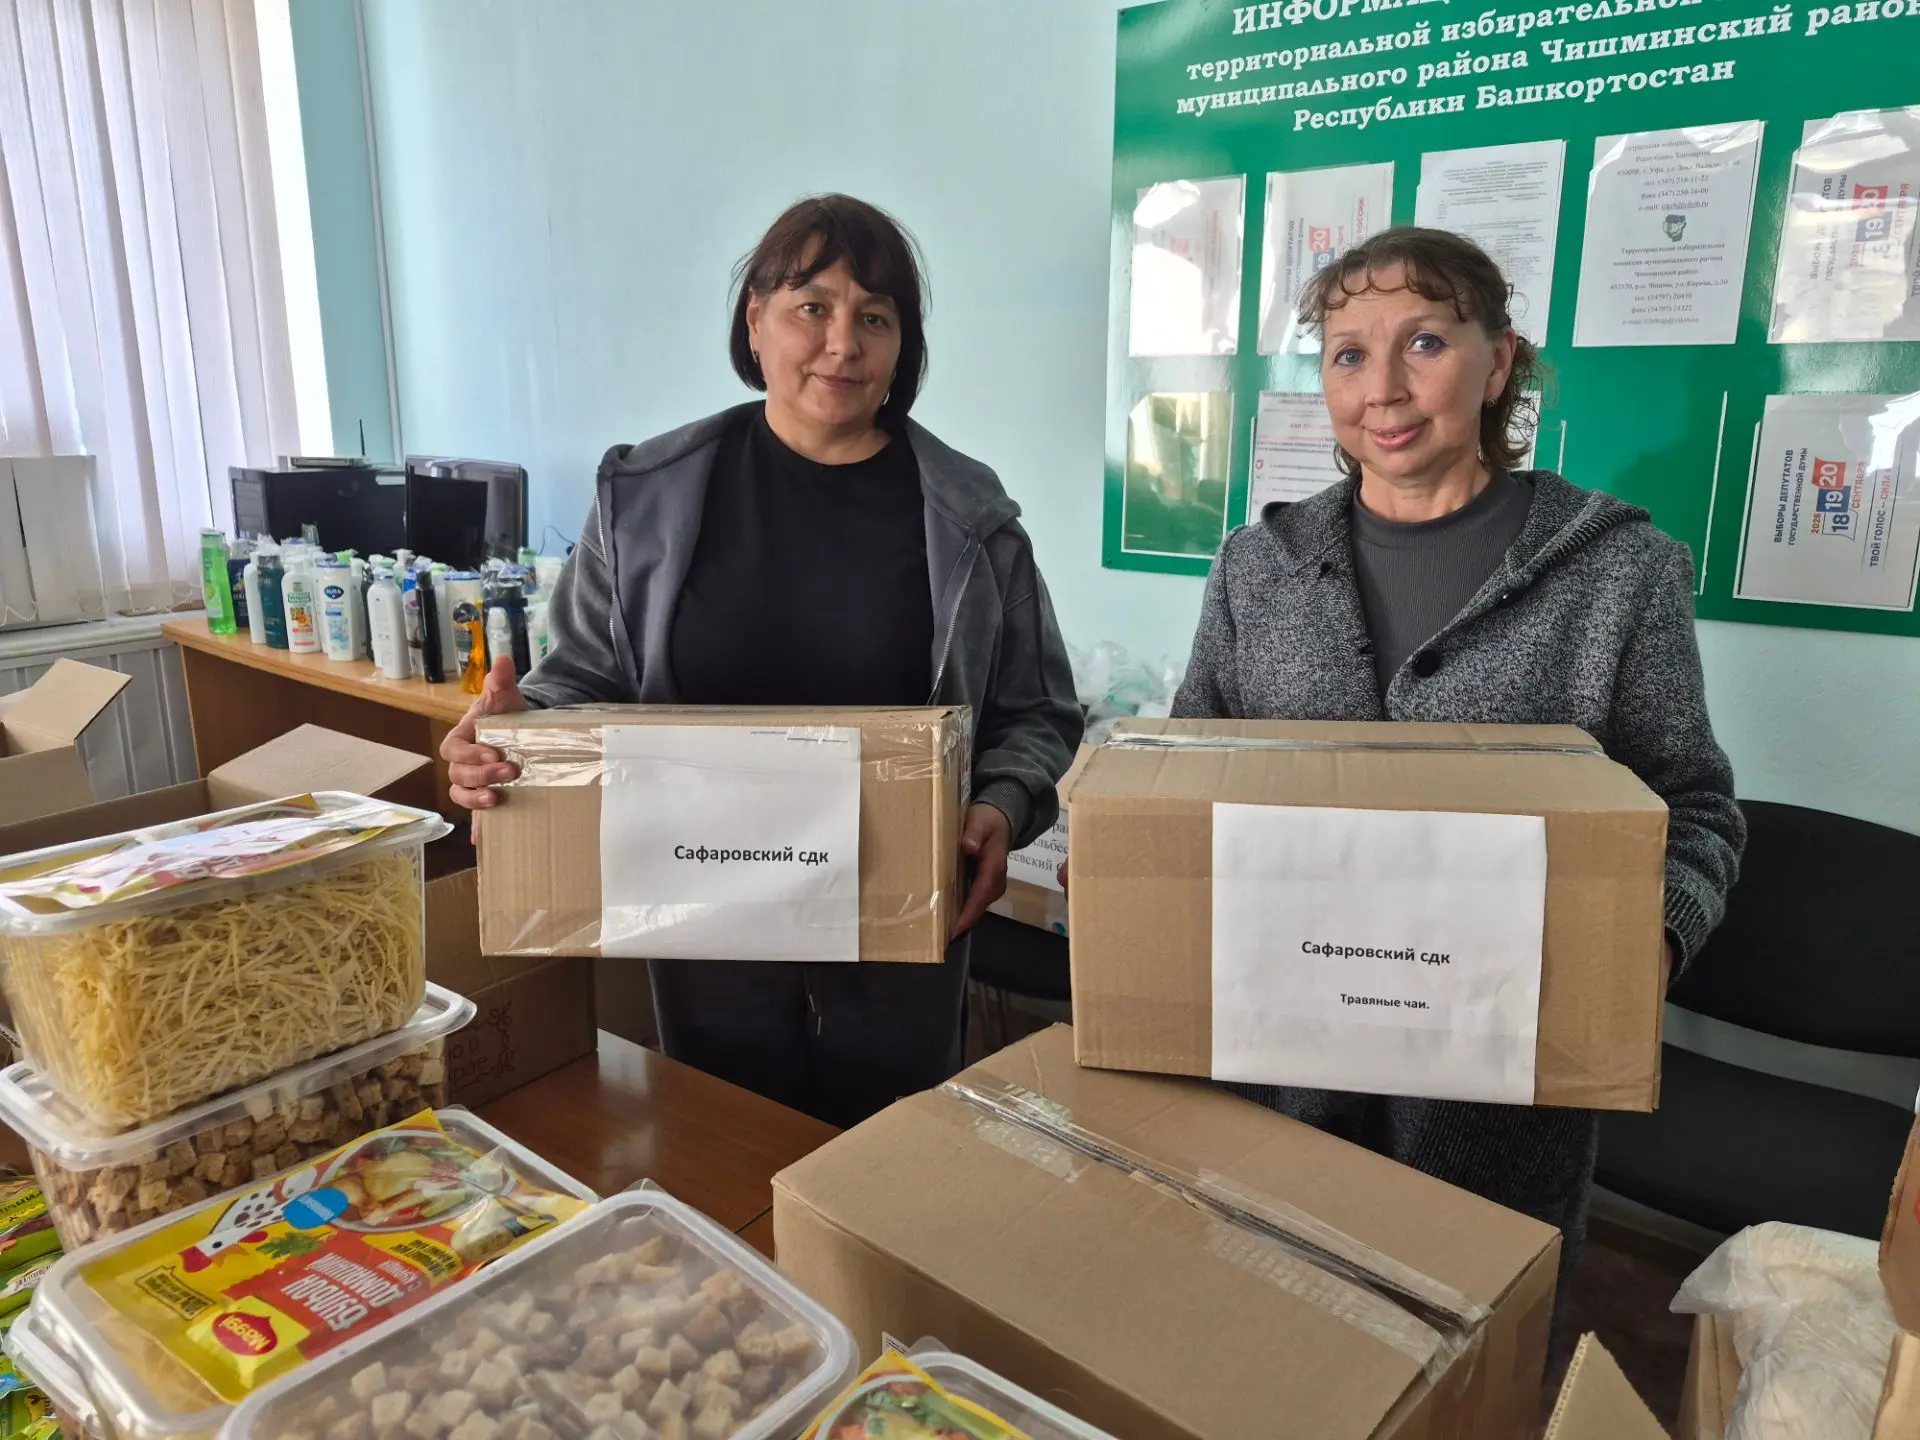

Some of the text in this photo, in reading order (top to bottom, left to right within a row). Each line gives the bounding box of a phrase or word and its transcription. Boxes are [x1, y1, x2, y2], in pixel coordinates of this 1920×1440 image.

[1176, 68, 1408, 117] муниципального
[1417, 50, 1529, 87] района
[1540, 4, 1794, 64] Чишминский
[1187, 21, 1430, 80] территориальной
[1293, 60, 1737, 131] Республики Башкортостан
[1312, 230, 1327, 252] 20
[1865, 217, 1885, 239] 19
[1818, 463, 1838, 488] 20
[1774, 449, 1794, 543] ВЫБОРЫ ДЕПУТАТОВ
[1788, 447, 1808, 546] ГОСУДАРСТВЕННОЙ ДУМЫ
[1824, 490, 1844, 511] 19
[1831, 514, 1850, 533] 18
[1874, 510, 1886, 544] ГОЛОС
[1869, 543, 1881, 568] ТВОЙ
[673, 844, 829, 865] Сафаровский сдк
[1300, 940, 1451, 966] Сафаровский сдк
[1339, 993, 1431, 1010] Травяные чаи.
[280, 1273, 368, 1332] БУЛЬОН
[219, 1316, 271, 1351] Maggi
